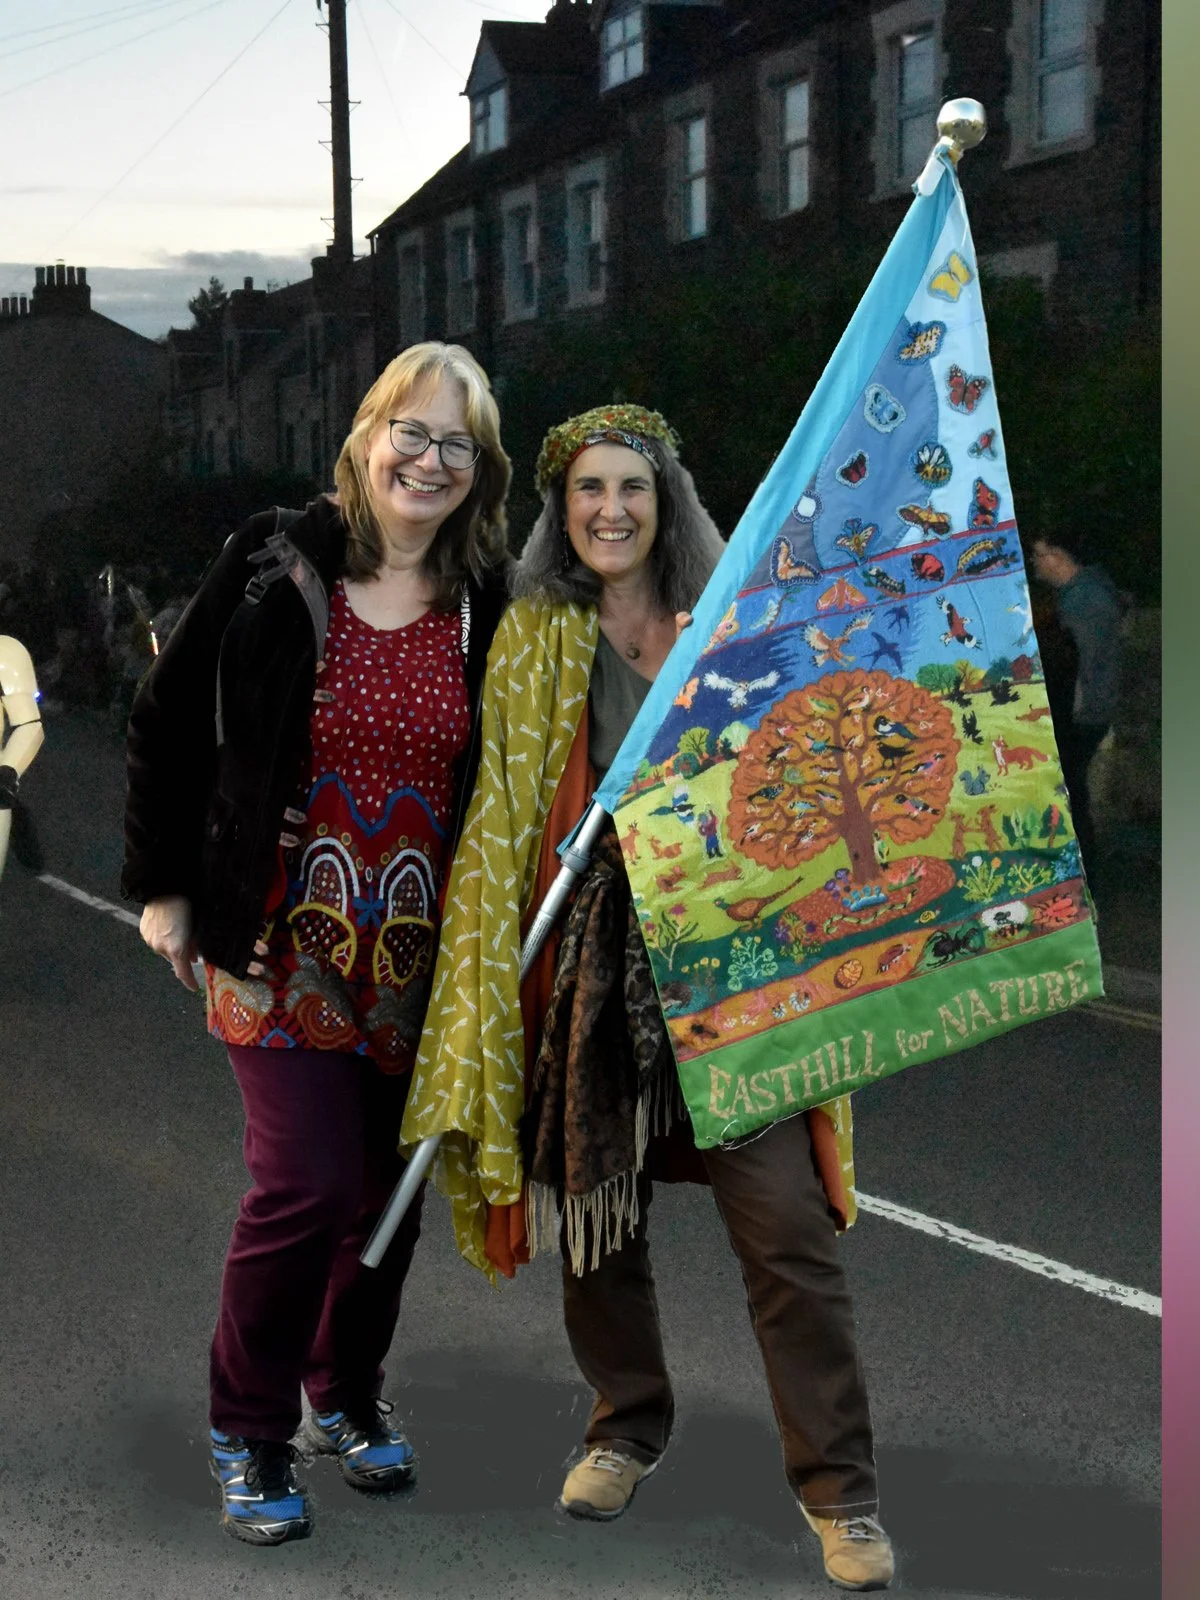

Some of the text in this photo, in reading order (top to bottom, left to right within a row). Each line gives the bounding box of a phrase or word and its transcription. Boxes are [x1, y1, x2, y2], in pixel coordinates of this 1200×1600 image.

[707, 959, 1091, 1120] EASTHILL for NATURE
